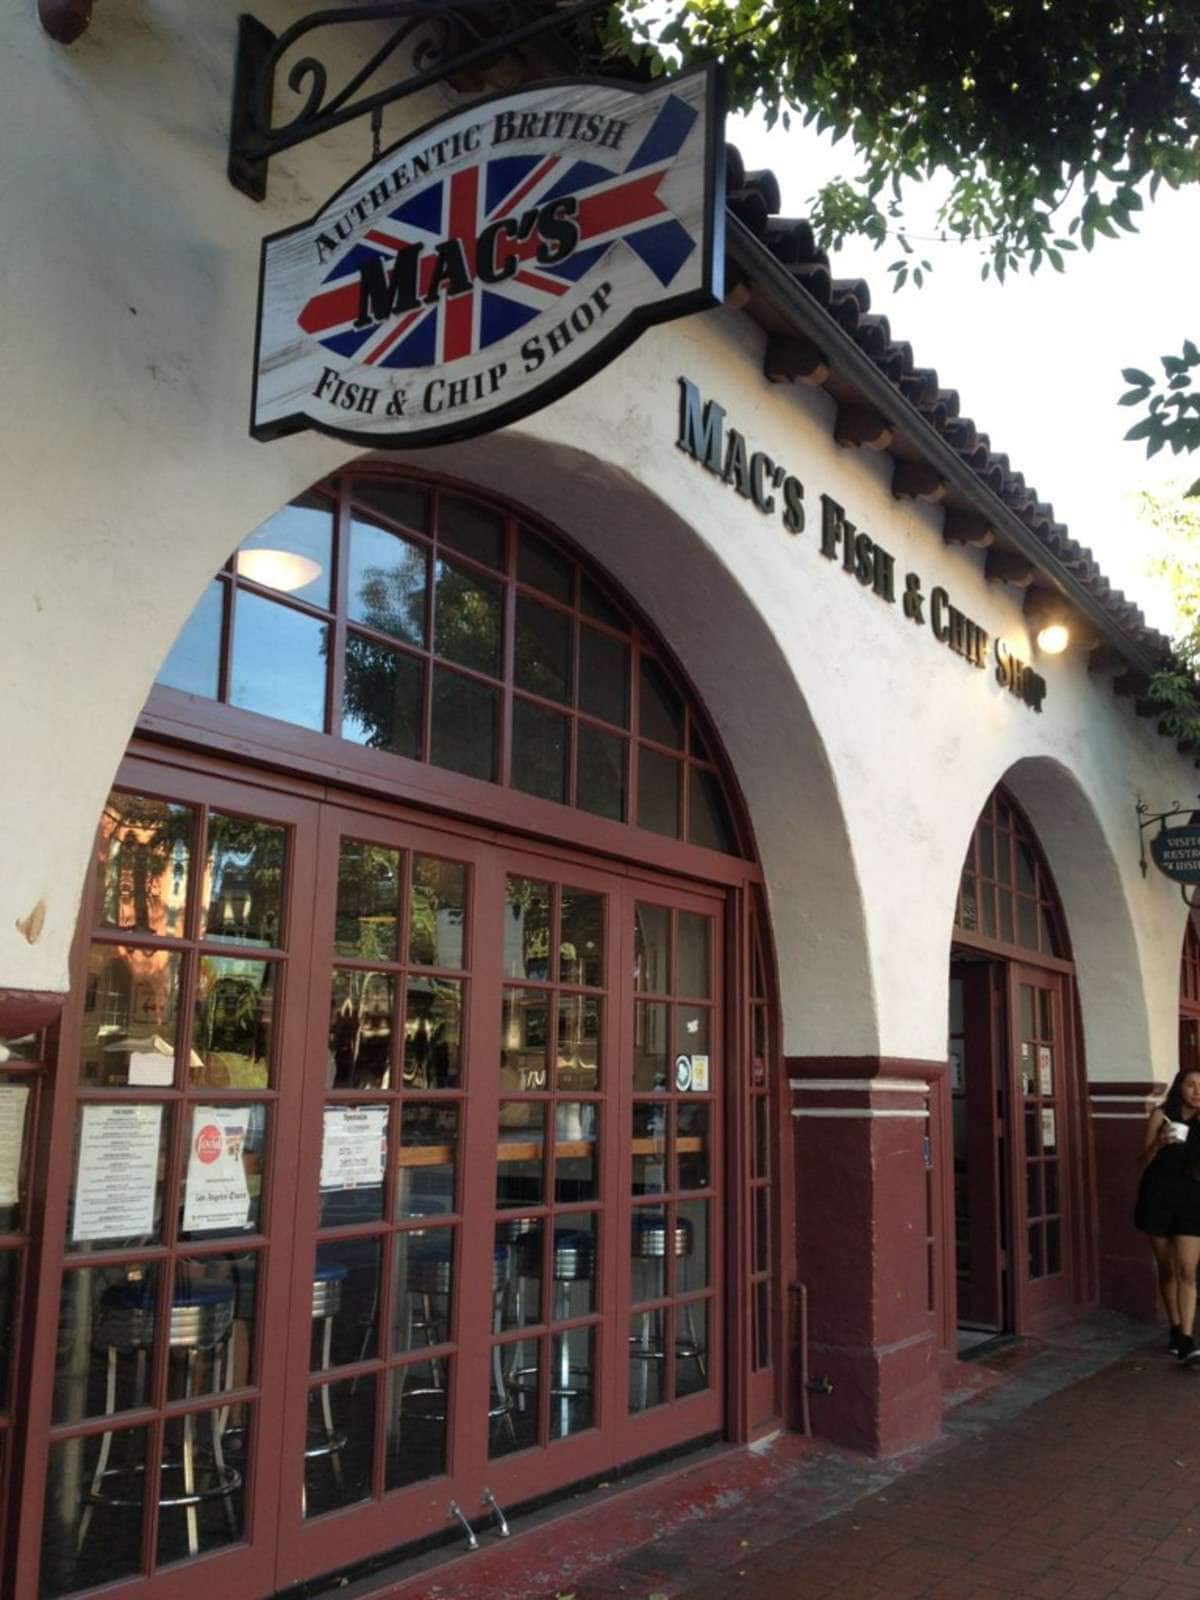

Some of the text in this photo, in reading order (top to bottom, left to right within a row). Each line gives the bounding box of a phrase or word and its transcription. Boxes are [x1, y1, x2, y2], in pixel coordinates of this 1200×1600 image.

[313, 109, 630, 266] AUTHENTIC BRITISH
[352, 196, 582, 332] MAC'S
[311, 281, 613, 417] FISH & CHIP SHOP
[676, 375, 1047, 714] MAC'S FISH & CHIP SHOP
